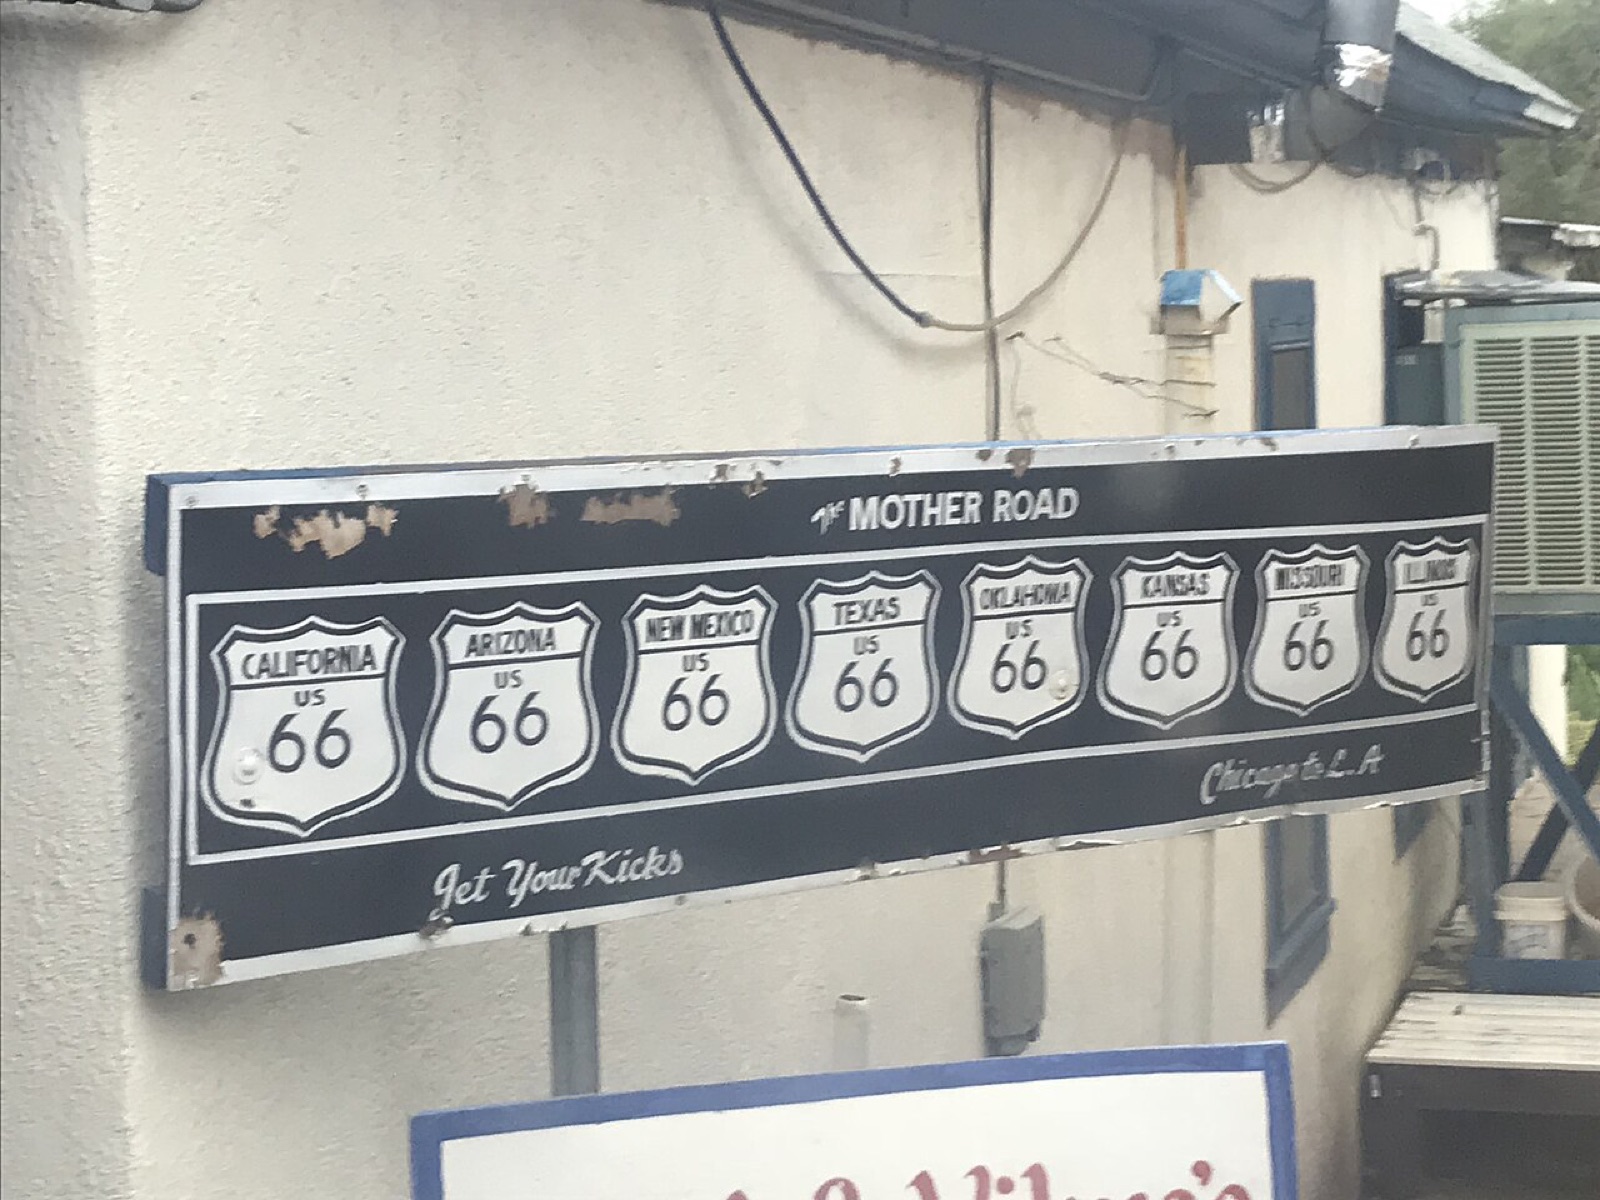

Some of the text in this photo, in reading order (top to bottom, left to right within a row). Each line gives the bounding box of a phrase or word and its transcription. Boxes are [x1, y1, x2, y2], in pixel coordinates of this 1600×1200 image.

[849, 490, 982, 531] MOTHER
[992, 487, 1080, 523] ROAD
[979, 579, 1072, 610] OKLAHOMA
[1140, 572, 1210, 599] KANSAS
[1274, 564, 1346, 591] MISSOURI
[646, 608, 756, 642] NEW MEXICO
[833, 595, 901, 626] TEXAS
[1157, 610, 1182, 627] US
[1299, 602, 1322, 619] US
[464, 627, 557, 659] ARIZONA
[853, 635, 880, 655] US
[1004, 619, 1033, 639] US
[1283, 619, 1334, 672] 66
[1404, 609, 1449, 662] 66
[241, 644, 376, 679] CALIFORNIA
[682, 653, 710, 673] US
[990, 639, 1047, 693] 66
[1141, 629, 1200, 682] 66
[493, 669, 523, 689] US
[834, 658, 899, 711] 66
[294, 687, 326, 706] US
[662, 673, 729, 732] 66
[470, 692, 549, 754] 66
[267, 708, 352, 773] 66
[1200, 759, 1300, 805] Chicago
[431, 846, 684, 914] Get Your Kicks
